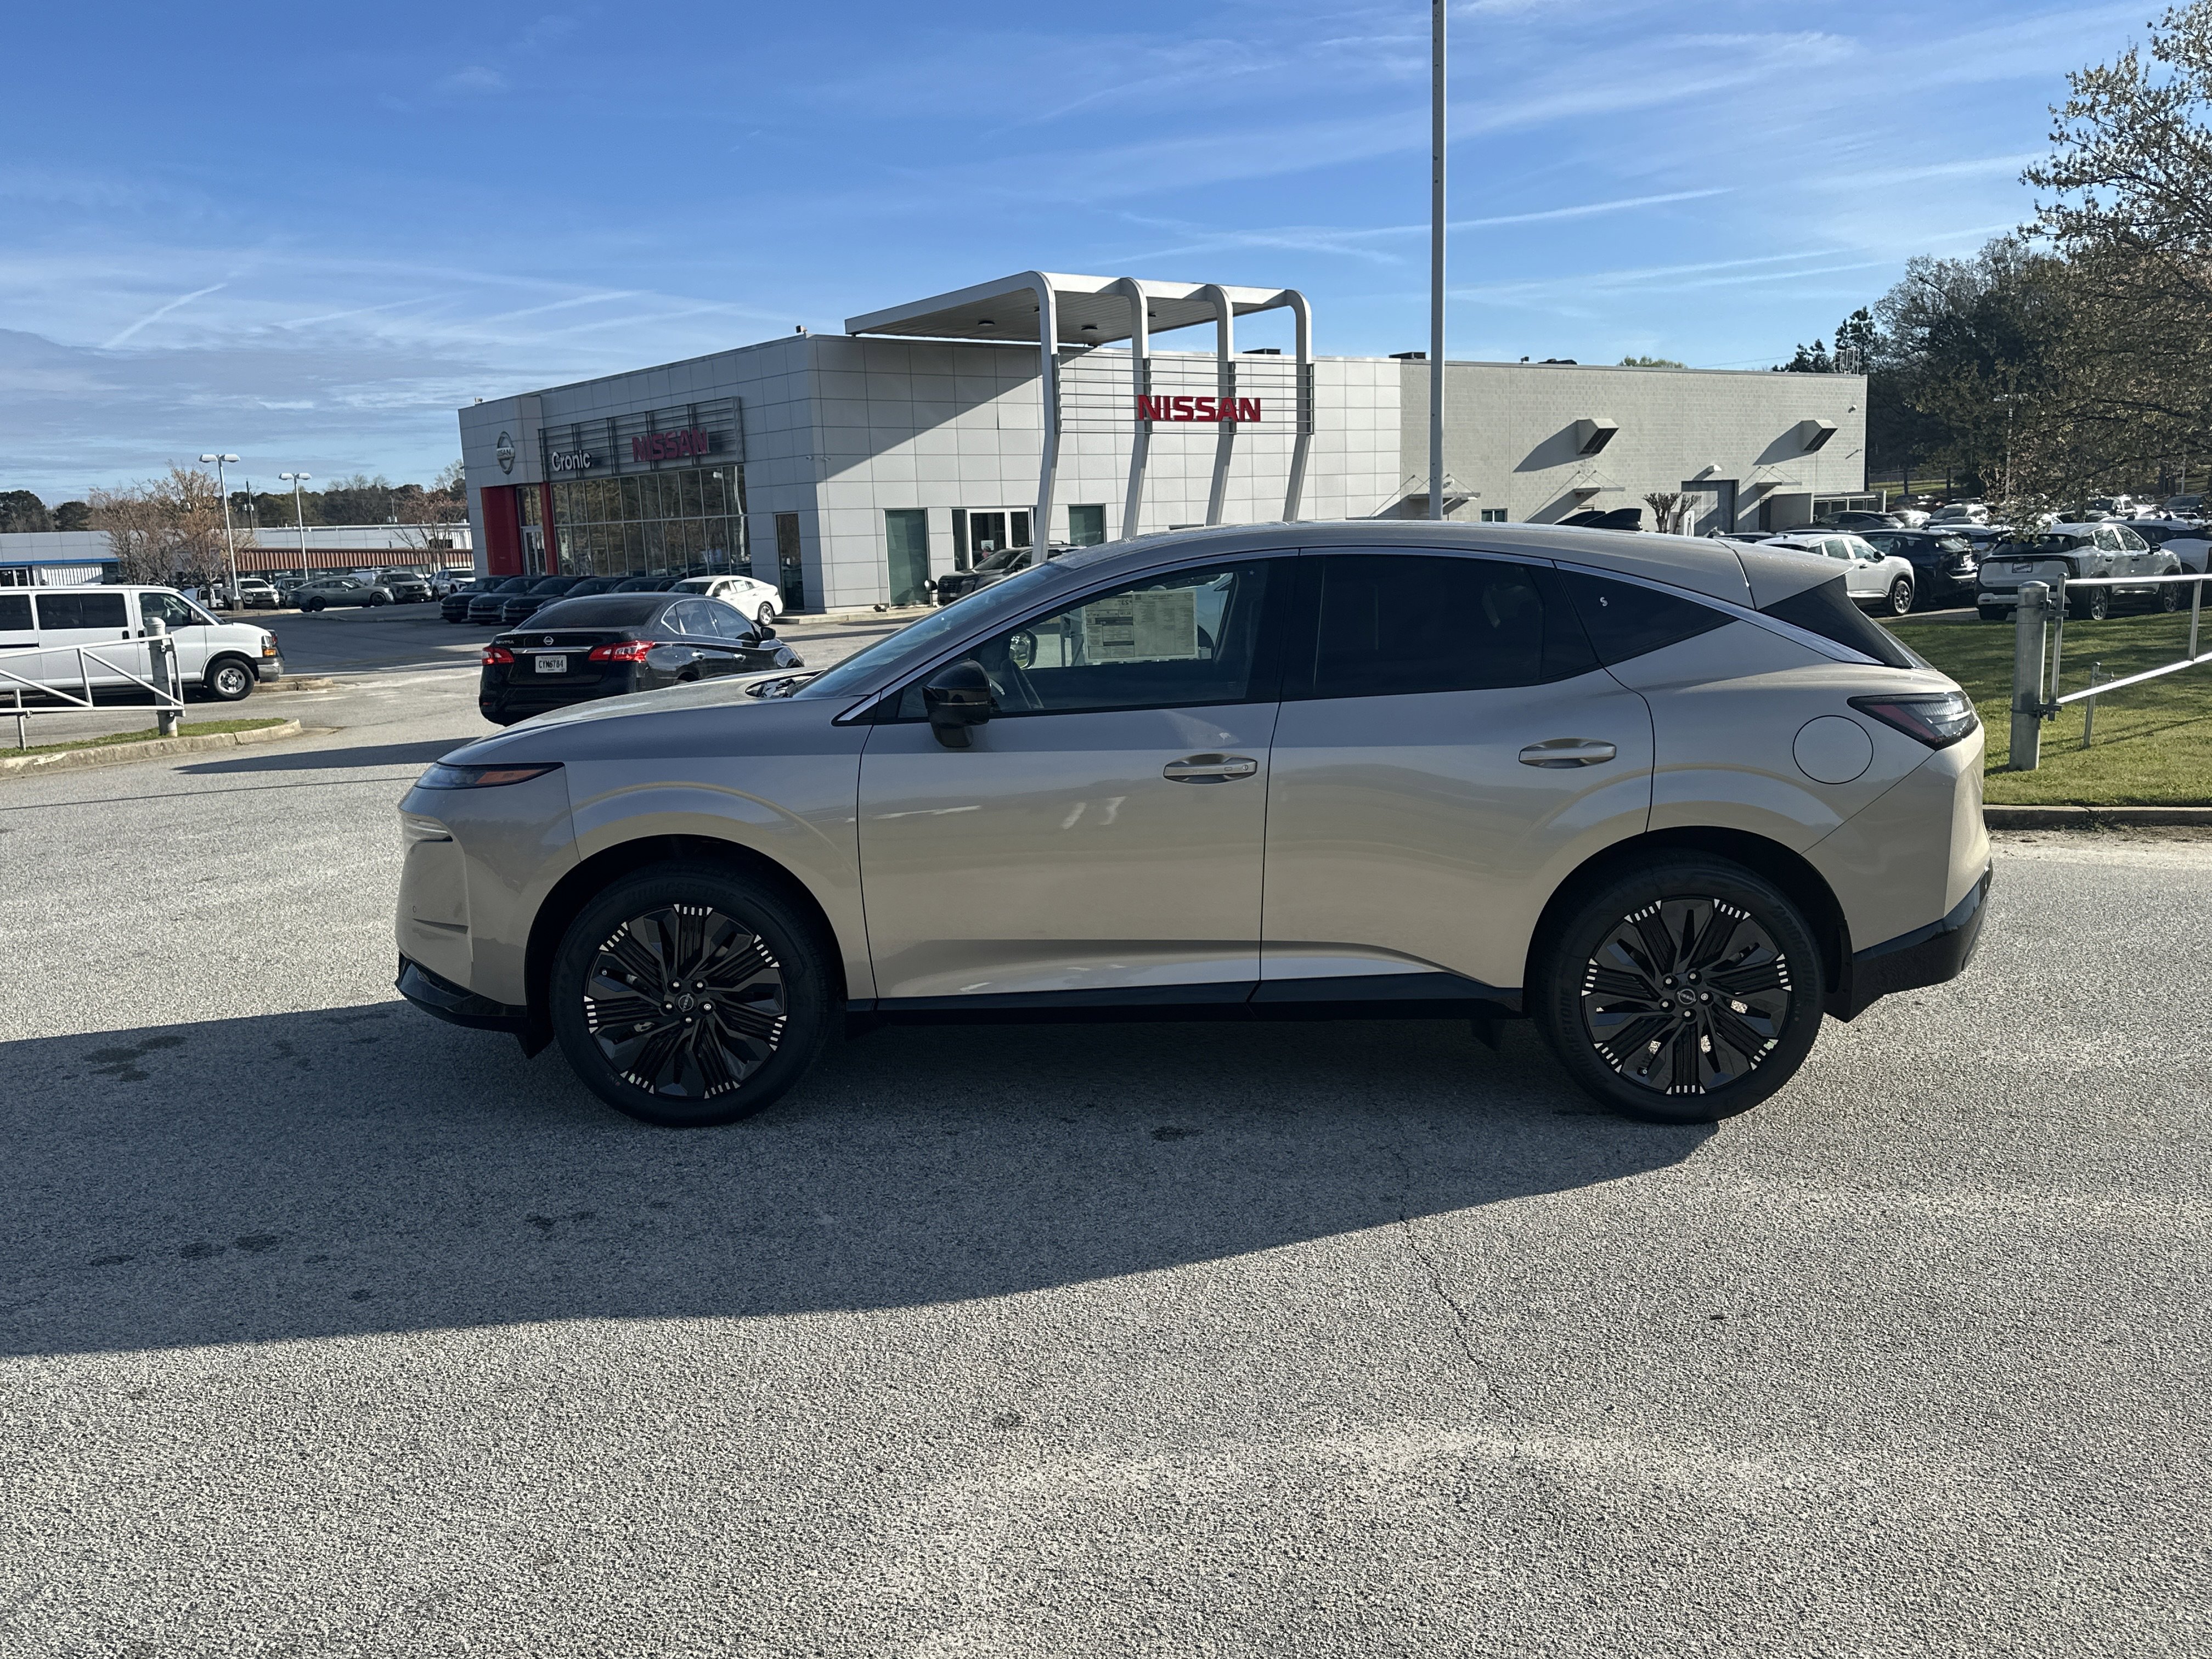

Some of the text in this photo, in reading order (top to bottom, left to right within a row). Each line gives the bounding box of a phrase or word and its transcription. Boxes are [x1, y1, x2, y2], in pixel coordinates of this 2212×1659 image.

[1137, 394, 1260, 422] NISSAN
[632, 427, 707, 461] NISSAN
[552, 450, 590, 471] Cronic
